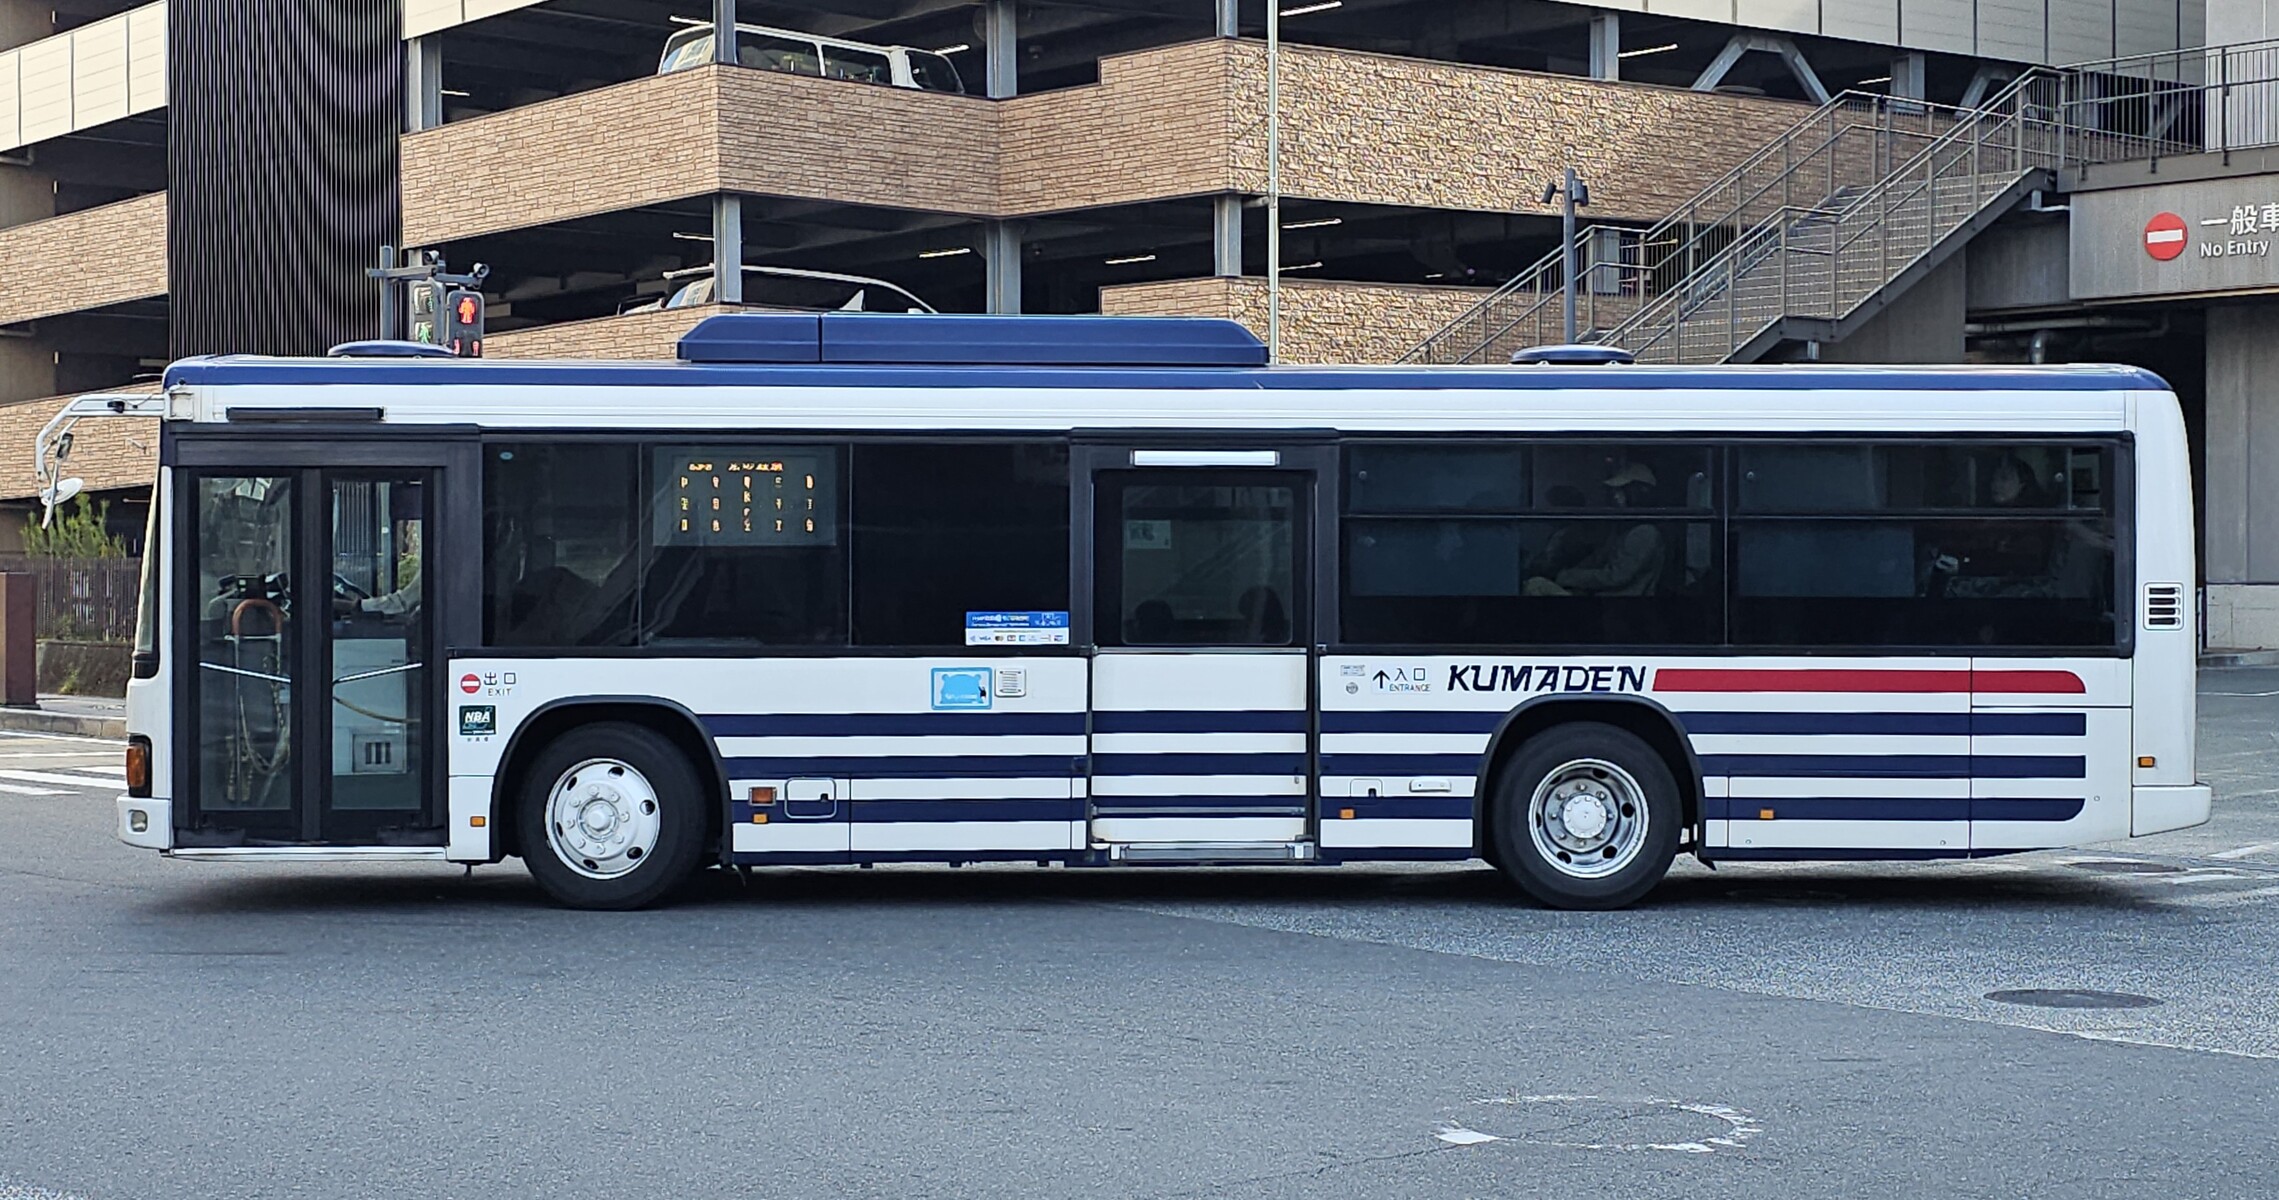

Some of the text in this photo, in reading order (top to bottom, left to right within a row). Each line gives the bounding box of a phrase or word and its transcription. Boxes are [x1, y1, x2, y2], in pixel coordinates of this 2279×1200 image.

[2201, 240, 2269, 258] No Entry
[484, 672, 516, 685] 出口
[1394, 668, 1425, 681] 入口
[1447, 665, 1647, 692] KUMADEN
[488, 688, 512, 696] EXIT
[1389, 683, 1431, 692] ENTRANCE
[465, 711, 490, 723] NBA
